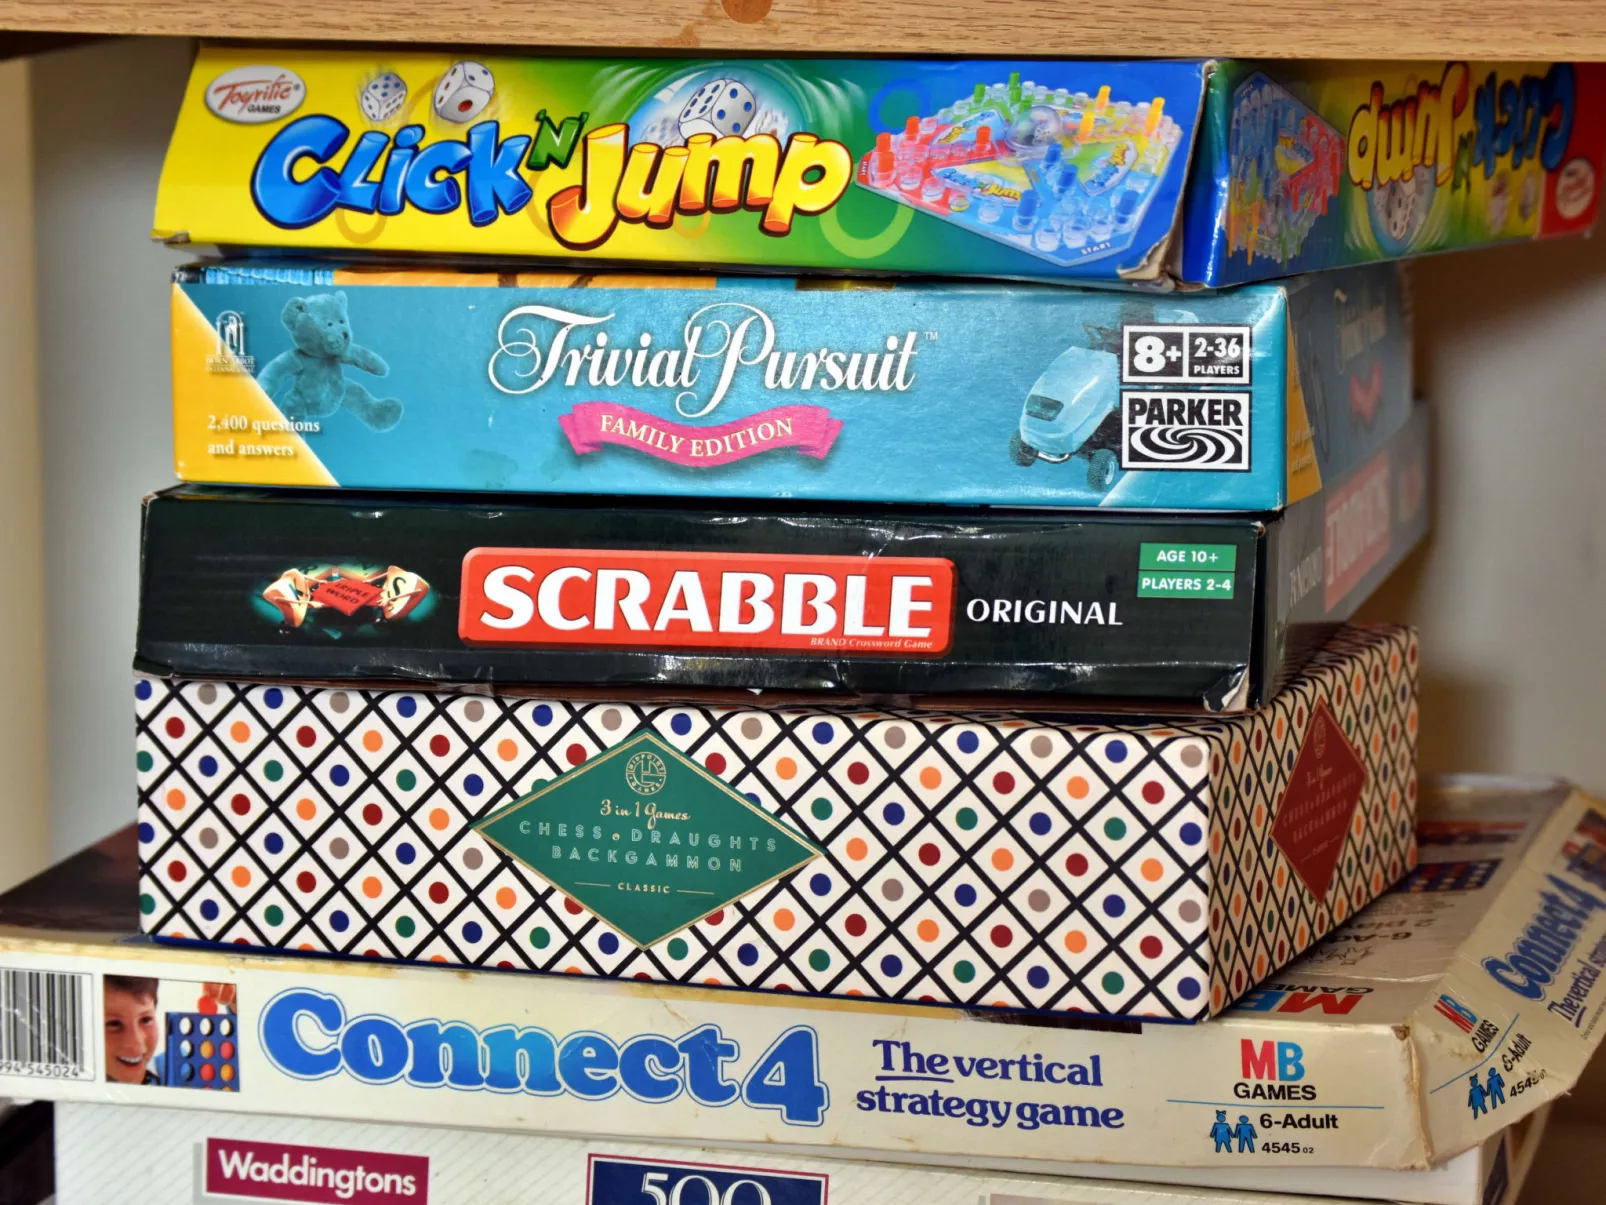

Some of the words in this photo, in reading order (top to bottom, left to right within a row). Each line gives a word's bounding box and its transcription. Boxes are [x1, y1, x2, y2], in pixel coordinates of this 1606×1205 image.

[247, 104, 281, 114] GAMES
[1347, 61, 1471, 192] Jump
[547, 122, 853, 251] Jump
[487, 304, 703, 395] Trivial
[676, 302, 918, 418] Pursuit
[1133, 335, 1182, 373] 8+
[1194, 337, 1241, 358] 2-36
[1193, 366, 1240, 375] PLAYERS
[207, 414, 248, 432] 2,400
[252, 416, 320, 436] questions
[1128, 398, 1244, 427] PARKER
[207, 439, 235, 455] and
[238, 444, 295, 456] answers
[600, 413, 685, 454] FAMILY
[690, 417, 794, 457] EDITION
[1156, 550, 1186, 562] AGE
[1191, 550, 1219, 563] 10+
[325, 588, 360, 605] WORD
[1141, 577, 1202, 591] PLAYERS
[1206, 578, 1232, 591] 2-4
[480, 565, 933, 639] SCRABBLE
[966, 598, 1124, 627] ORIGINAL
[810, 637, 846, 647] BRAND
[848, 638, 901, 648] Crossword
[903, 639, 933, 649] Game
[600, 799, 612, 816] 3
[615, 802, 633, 816] in
[635, 800, 640, 817] 1
[644, 802, 691, 830] Games
[519, 820, 602, 840] CHESS
[631, 828, 777, 852] DRAUGHTS
[552, 845, 742, 872] BACKGAMMON
[618, 882, 671, 894] CLASSIC
[1433, 993, 1477, 1034] MB
[1471, 1019, 1500, 1054] GAMES
[872, 1039, 950, 1075] The
[953, 1053, 1104, 1087] vertical
[1240, 1038, 1305, 1081] MB
[1501, 1032, 1532, 1073] 6-Adult
[27, 1063, 79, 1078] 545024
[1233, 1082, 1317, 1100] GAMES
[856, 1085, 1012, 1129] strategy
[1017, 1101, 1125, 1131] game
[1259, 1113, 1339, 1129] 6-Adult
[1261, 1142, 1301, 1154] 4545
[218, 1148, 418, 1200] Waddingtons
